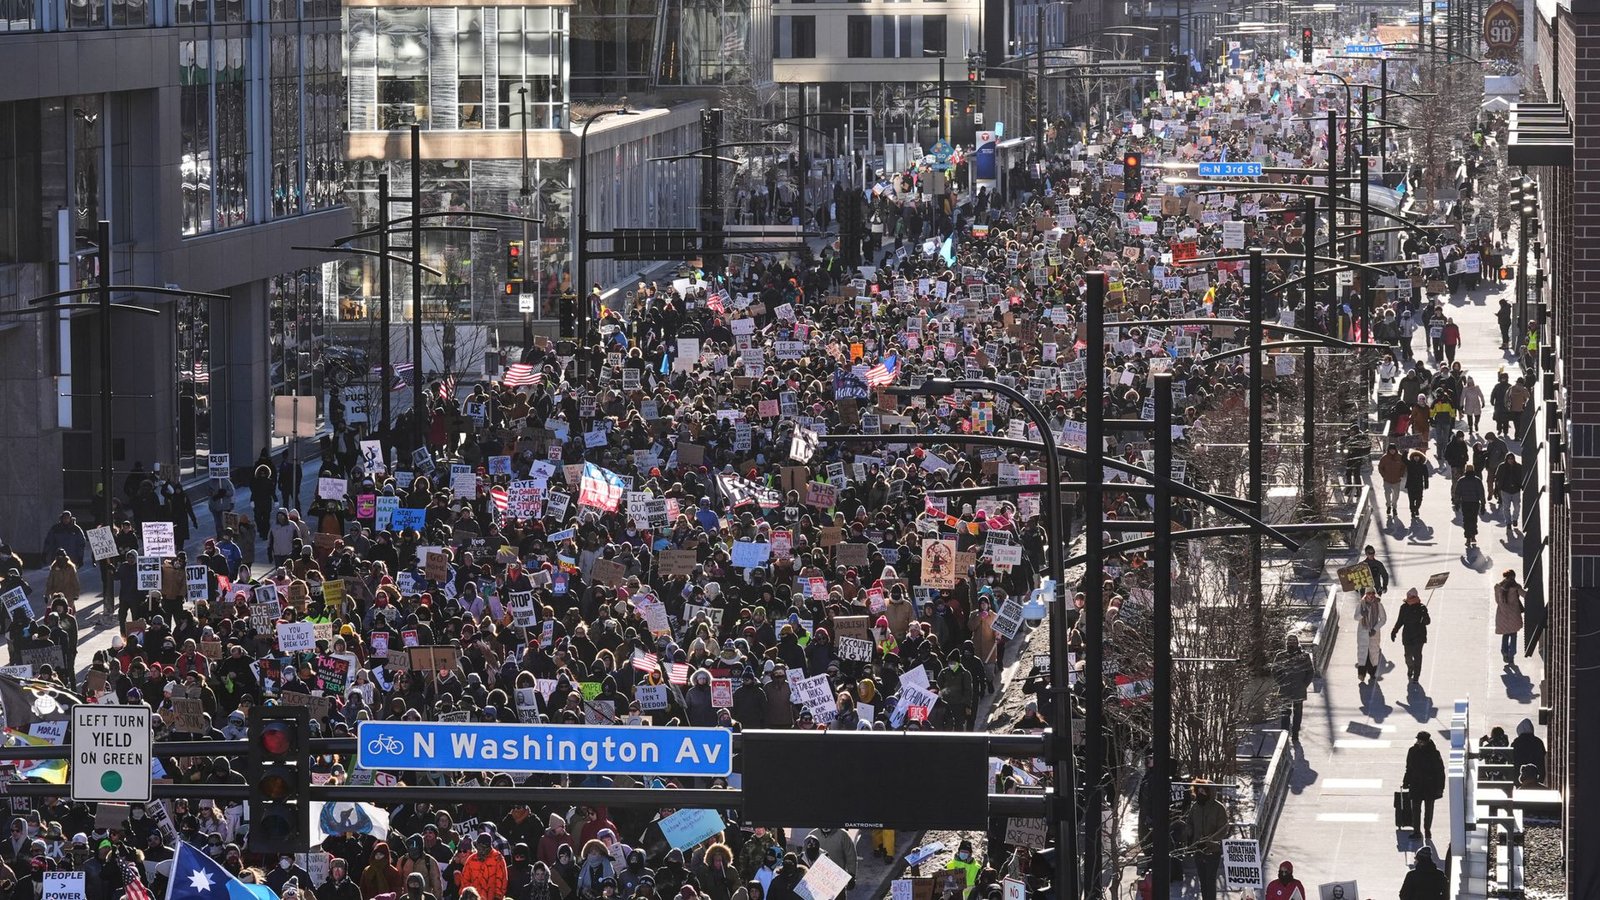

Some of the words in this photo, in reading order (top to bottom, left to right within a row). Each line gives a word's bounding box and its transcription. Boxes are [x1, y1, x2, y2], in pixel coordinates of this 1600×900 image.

[1225, 165, 1243, 173] 3rd
[1247, 165, 1260, 173] St
[966, 370, 983, 379] STOP
[580, 396, 596, 406] STOP
[470, 404, 482, 415] ICE
[1069, 421, 1085, 430] ICE
[210, 455, 218, 463] ICE
[218, 455, 228, 463] OUT
[453, 466, 461, 474] ICE
[828, 469, 843, 477] ICE
[812, 483, 835, 495] DHS
[557, 494, 568, 505] OUT
[631, 494, 646, 503] ICE
[807, 492, 834, 507] LIES
[515, 501, 541, 510] STUPID
[89, 528, 108, 537] SHUT
[988, 531, 1009, 539] GENERAL
[987, 537, 1007, 545] STRIKE
[95, 546, 114, 556] DONNY
[429, 554, 444, 562] GO
[138, 563, 160, 571] ICE
[186, 566, 206, 581] STOP
[1347, 568, 1370, 581] MELT
[1354, 578, 1373, 589] ICE
[510, 592, 531, 608] STOP
[250, 604, 267, 616] ICE
[252, 615, 269, 625] OUT
[835, 619, 865, 630] ABOLISH
[997, 614, 1017, 630] MURDER
[253, 625, 272, 635] NOW
[288, 626, 301, 634] YOU
[281, 633, 297, 641] WILL
[296, 631, 310, 640] NOT
[283, 641, 299, 649] BREAK
[840, 637, 873, 649] ACCOUNT
[838, 645, 872, 656] ABILITY
[798, 680, 813, 691] TAKE
[818, 695, 834, 705] BACK
[79, 715, 106, 727] LEFT
[113, 715, 144, 728] TURN
[36, 726, 62, 737] MORAL
[92, 732, 133, 748] YIELD
[413, 732, 434, 759] N
[450, 732, 660, 771] Washington
[674, 736, 722, 765] Av
[81, 752, 97, 765] ON
[103, 751, 144, 766] GREEN
[13, 796, 30, 811] ICE
[1009, 816, 1048, 831] ABOLISH
[1226, 846, 1257, 856] JONATHAN
[1228, 853, 1244, 863] ROSS
[1244, 854, 1256, 863] FOR
[44, 872, 84, 880] PEOPLE
[1227, 865, 1260, 878] MURDER
[1228, 877, 1260, 885] NOW!
[45, 892, 81, 900] POWER
[1009, 886, 1020, 899] NO
